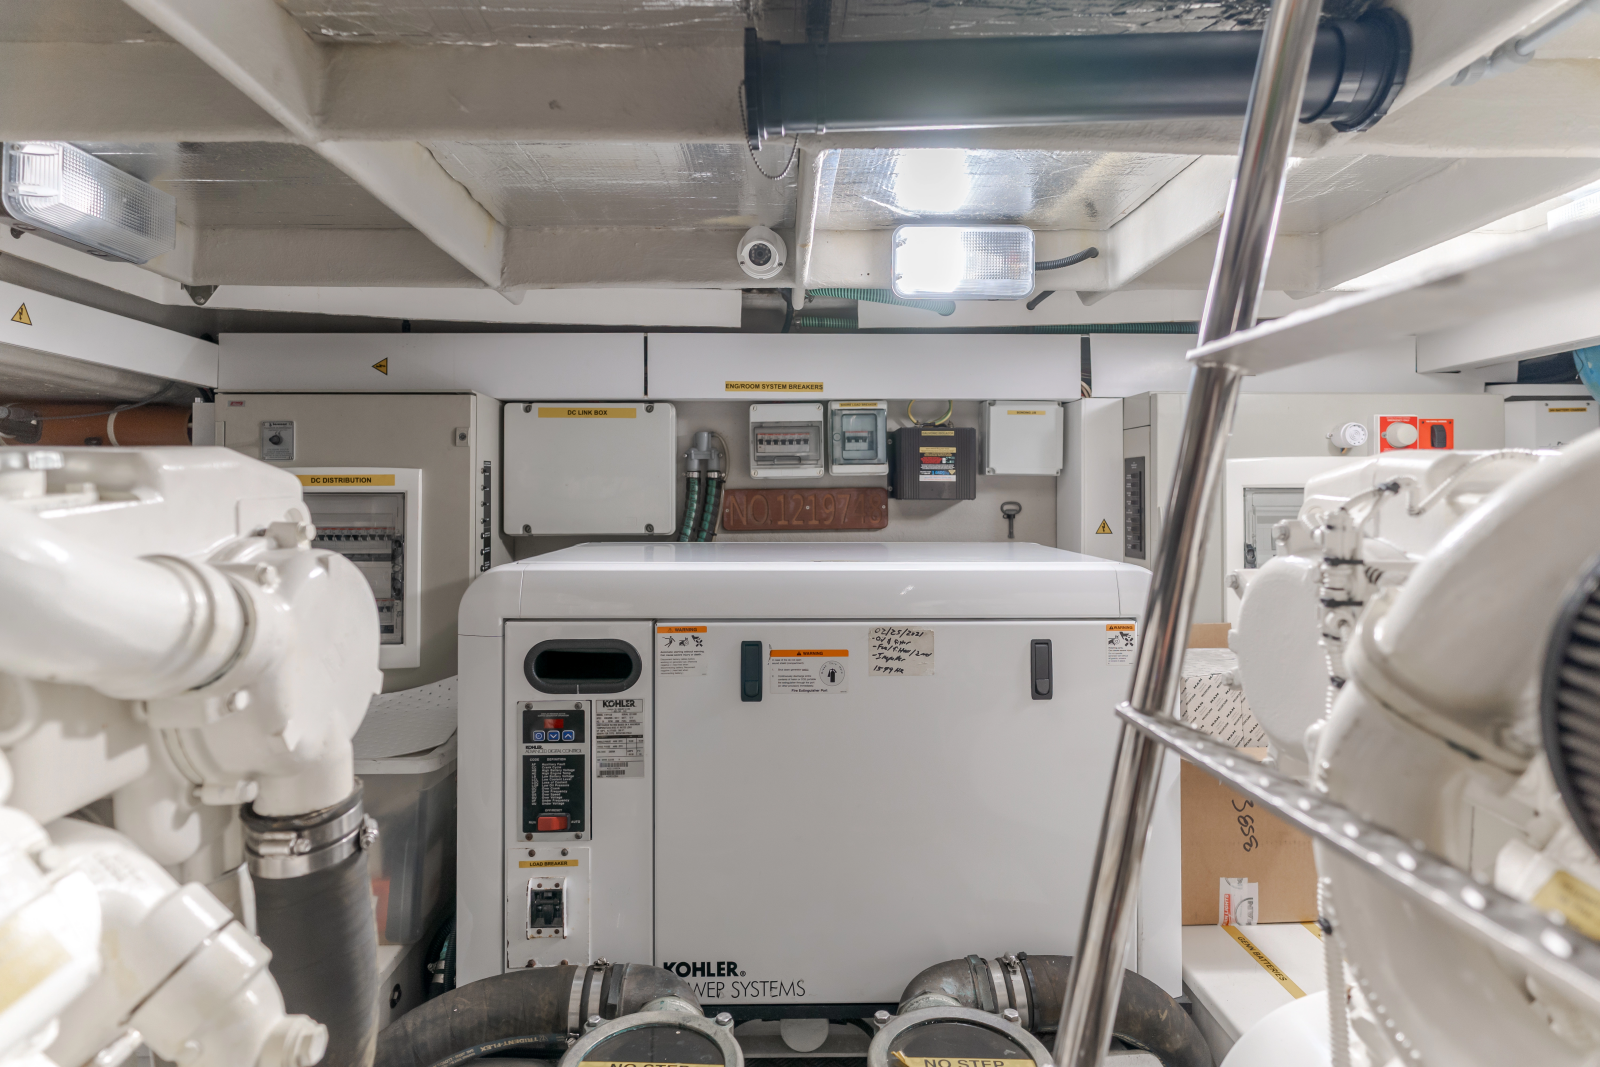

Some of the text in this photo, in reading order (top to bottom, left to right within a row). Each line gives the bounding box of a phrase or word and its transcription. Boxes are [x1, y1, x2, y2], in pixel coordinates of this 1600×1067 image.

[788, 383, 823, 391] BREAKERS
[602, 699, 636, 708] KOHLER
[1237, 936, 1288, 982] GENN BATTERIES
[730, 979, 806, 999] SYSTEMS
